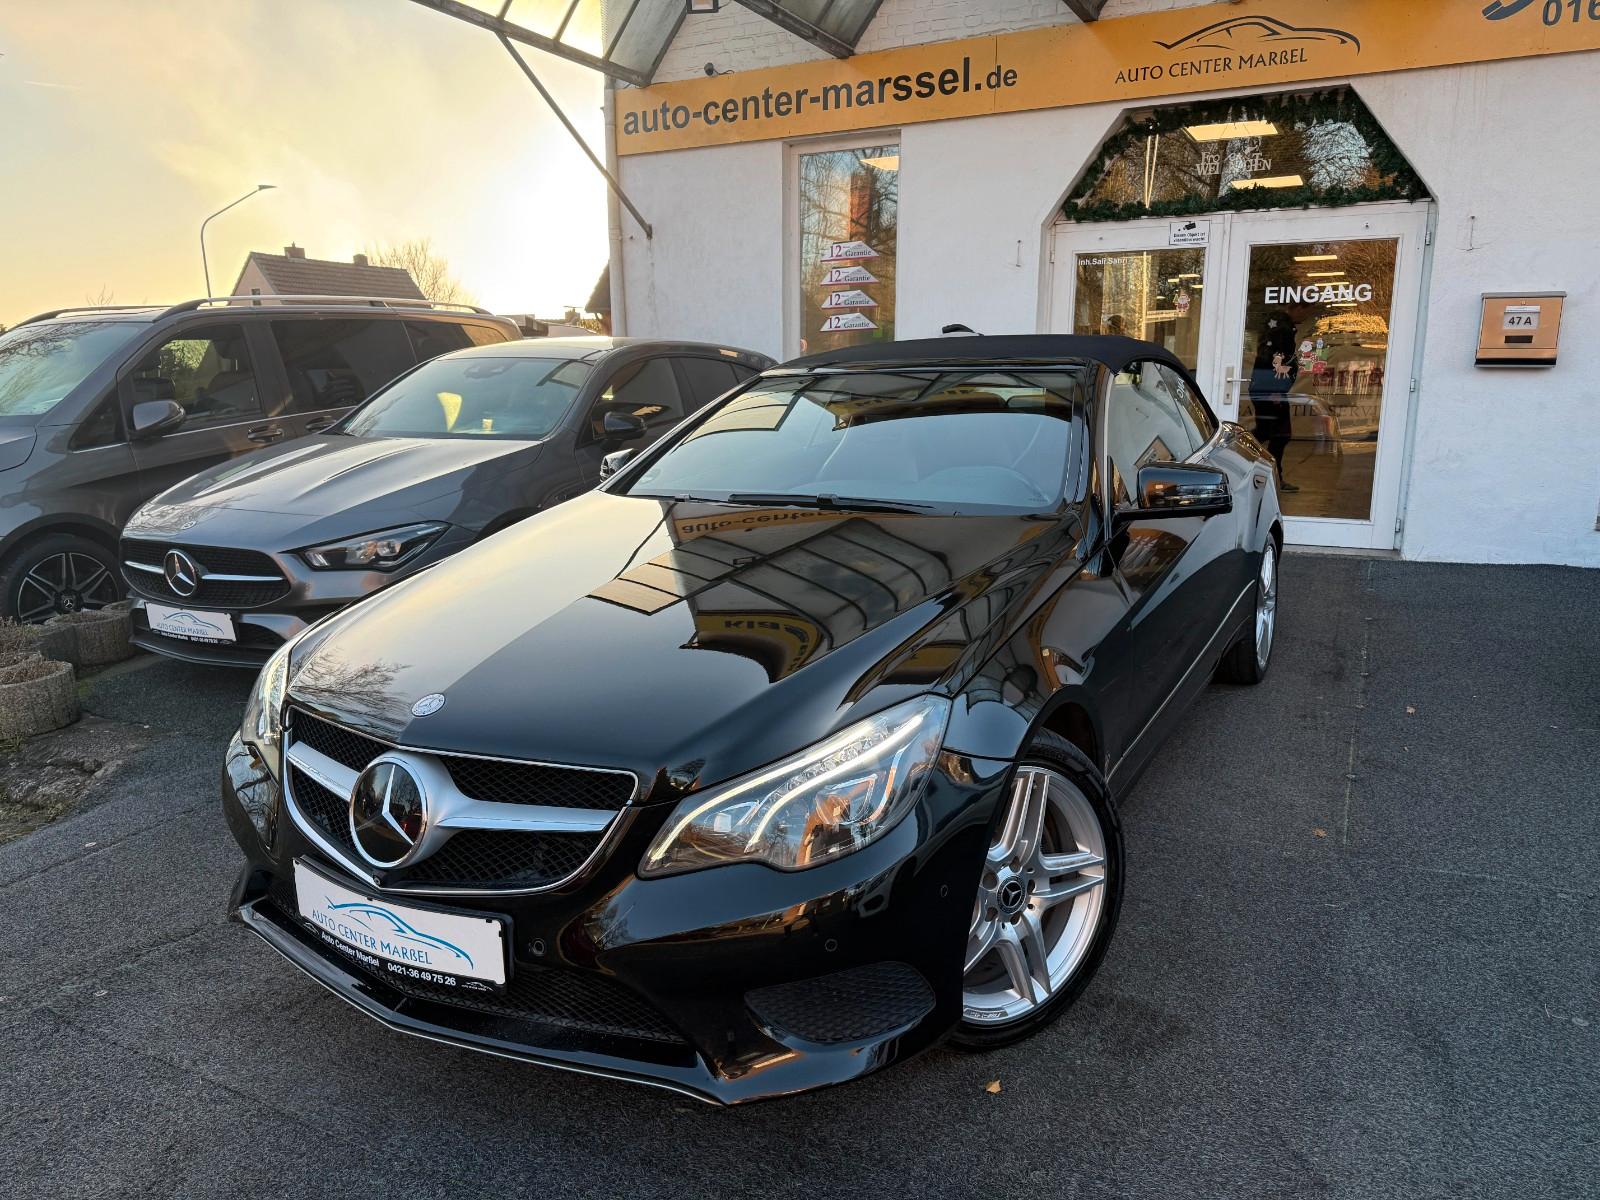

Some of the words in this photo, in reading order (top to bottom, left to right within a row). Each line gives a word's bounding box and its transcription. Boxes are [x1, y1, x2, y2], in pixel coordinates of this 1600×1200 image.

[1114, 65, 1163, 84] AUTO
[1168, 57, 1233, 78] CENTER
[623, 56, 1018, 136] auto-center-marssel.de
[830, 244, 843, 258] 12
[844, 249, 872, 257] Garantie
[829, 269, 842, 282] 12
[844, 274, 871, 282] Garantie
[829, 293, 842, 306] 12
[1264, 283, 1372, 305] EINGANG
[828, 316, 841, 329] 12
[843, 321, 870, 329] Garantie
[1508, 316, 1522, 325] 47
[1523, 316, 1532, 326] A
[312, 909, 336, 931] AUTO
[337, 924, 377, 950] CENTER
[380, 940, 433, 965] MARßEL
[321, 931, 335, 945] Auto
[335, 939, 355, 956] Center
[387, 962, 420, 979] 0421-36
[420, 971, 432, 981] 49
[433, 974, 444, 984] 75
[444, 977, 457, 986] 26
